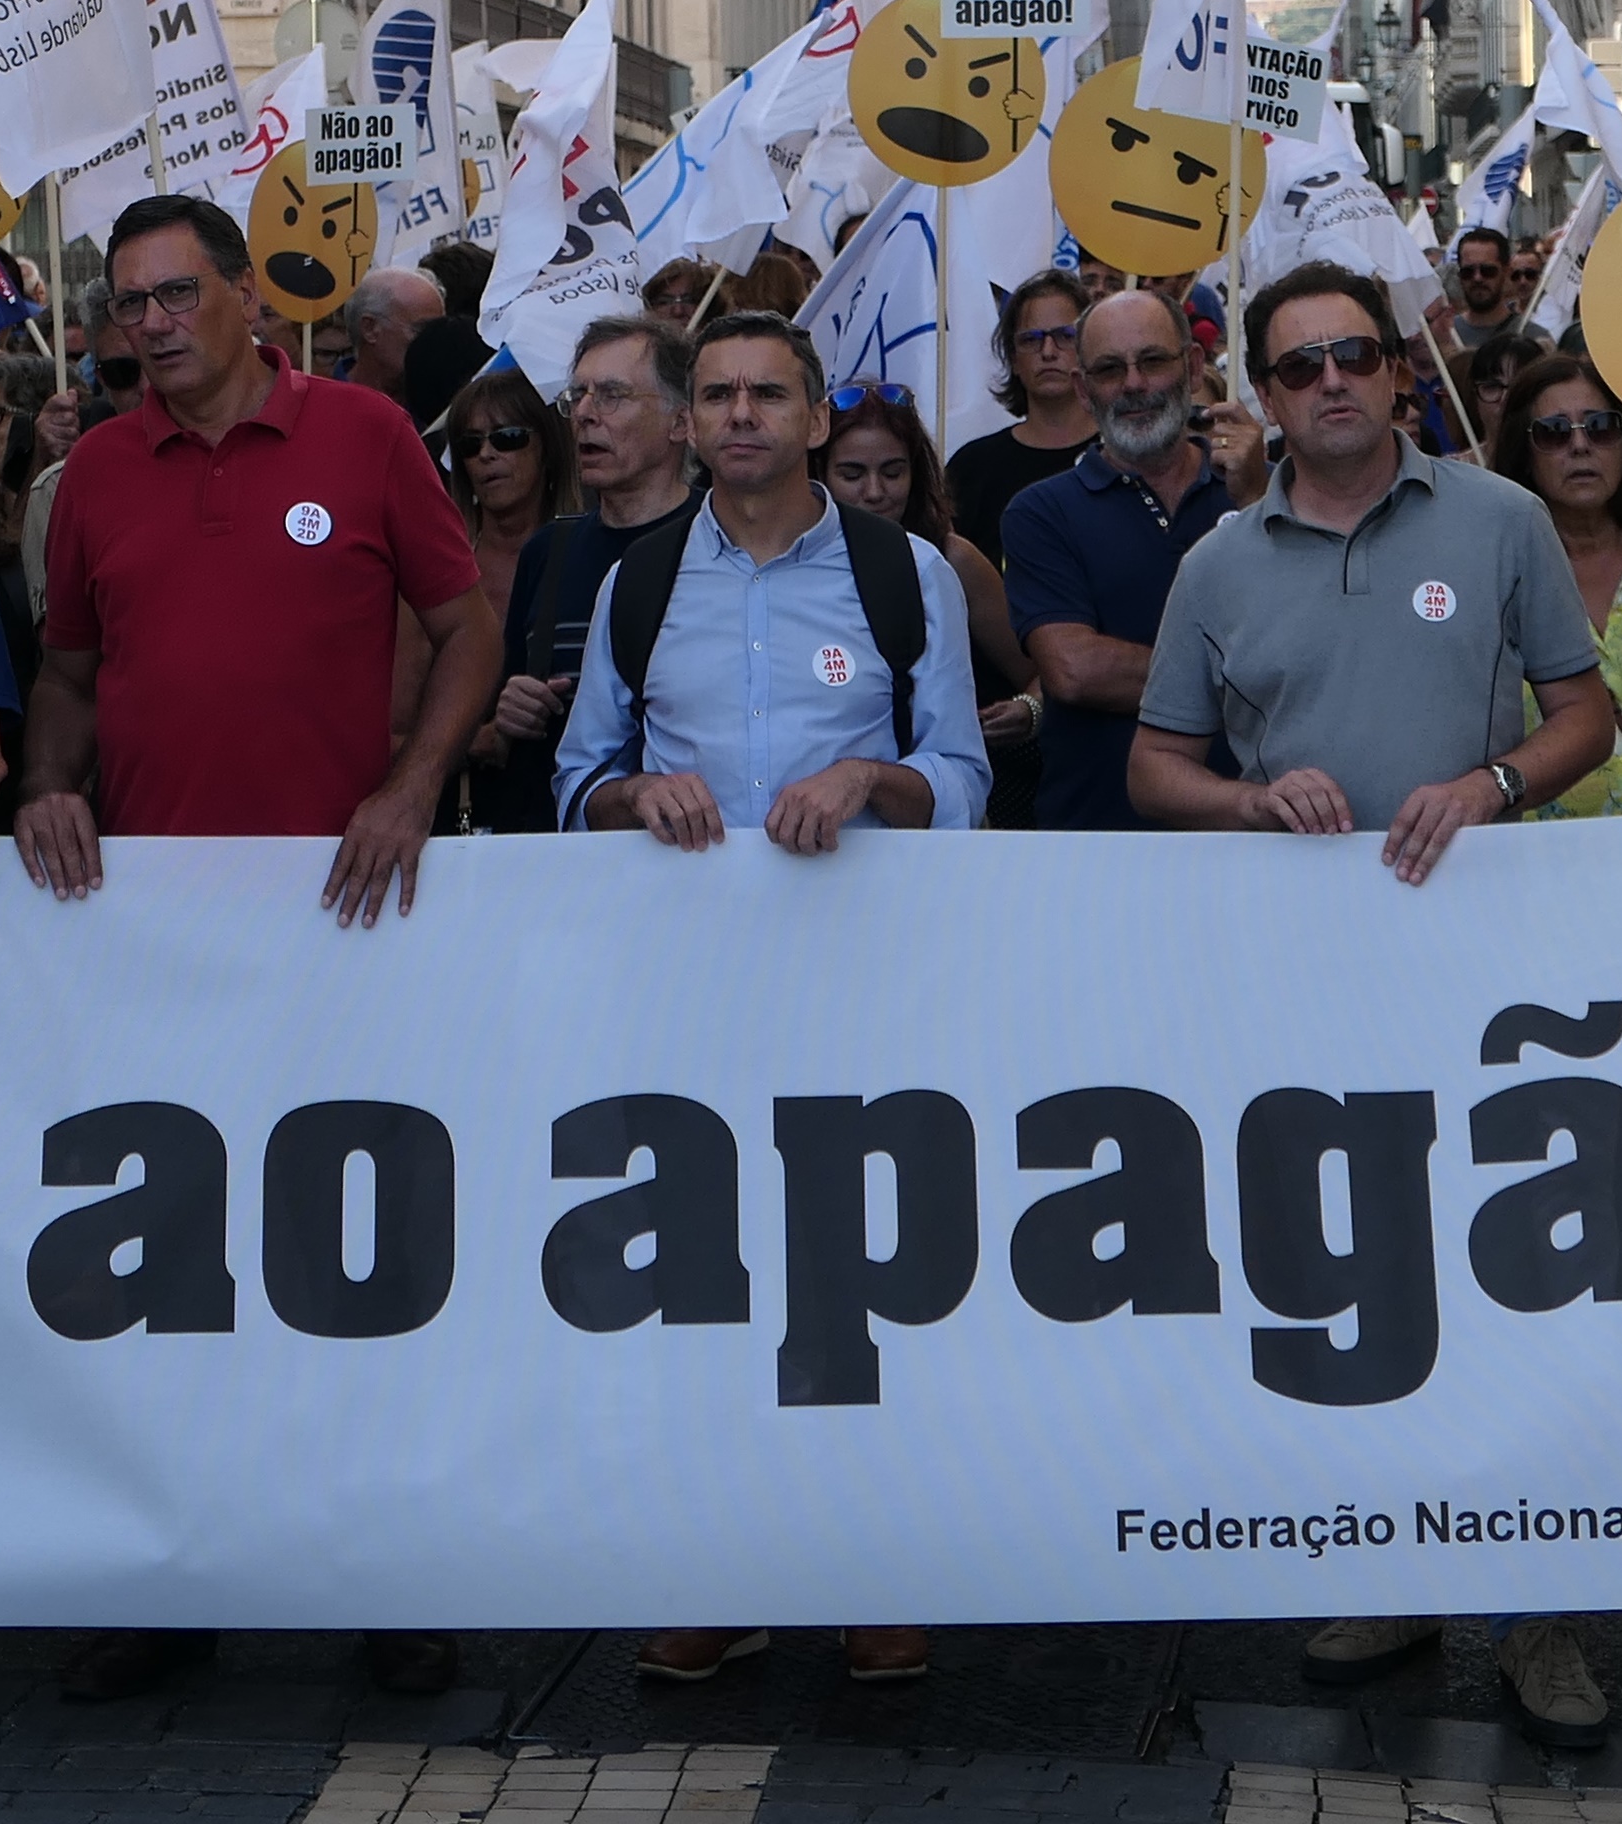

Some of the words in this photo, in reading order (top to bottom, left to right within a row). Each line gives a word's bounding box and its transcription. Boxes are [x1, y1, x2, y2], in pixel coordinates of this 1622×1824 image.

[1246, 43, 1323, 81] NTAÇÃO
[1245, 98, 1299, 128] rviço
[320, 112, 357, 140] Não
[364, 114, 394, 138] ao
[314, 141, 402, 175] apagão!
[301, 505, 321, 519] 9A
[297, 517, 320, 531] 4M
[296, 528, 317, 541] 2D
[1426, 584, 1445, 596] 9A
[1424, 596, 1446, 607] 4M
[1425, 607, 1445, 618] 2D
[822, 647, 843, 660] 9A
[823, 659, 846, 671] 4M
[827, 671, 847, 684] 2D
[25, 1098, 456, 1342] ao
[1114, 1505, 1396, 1560] Federação
